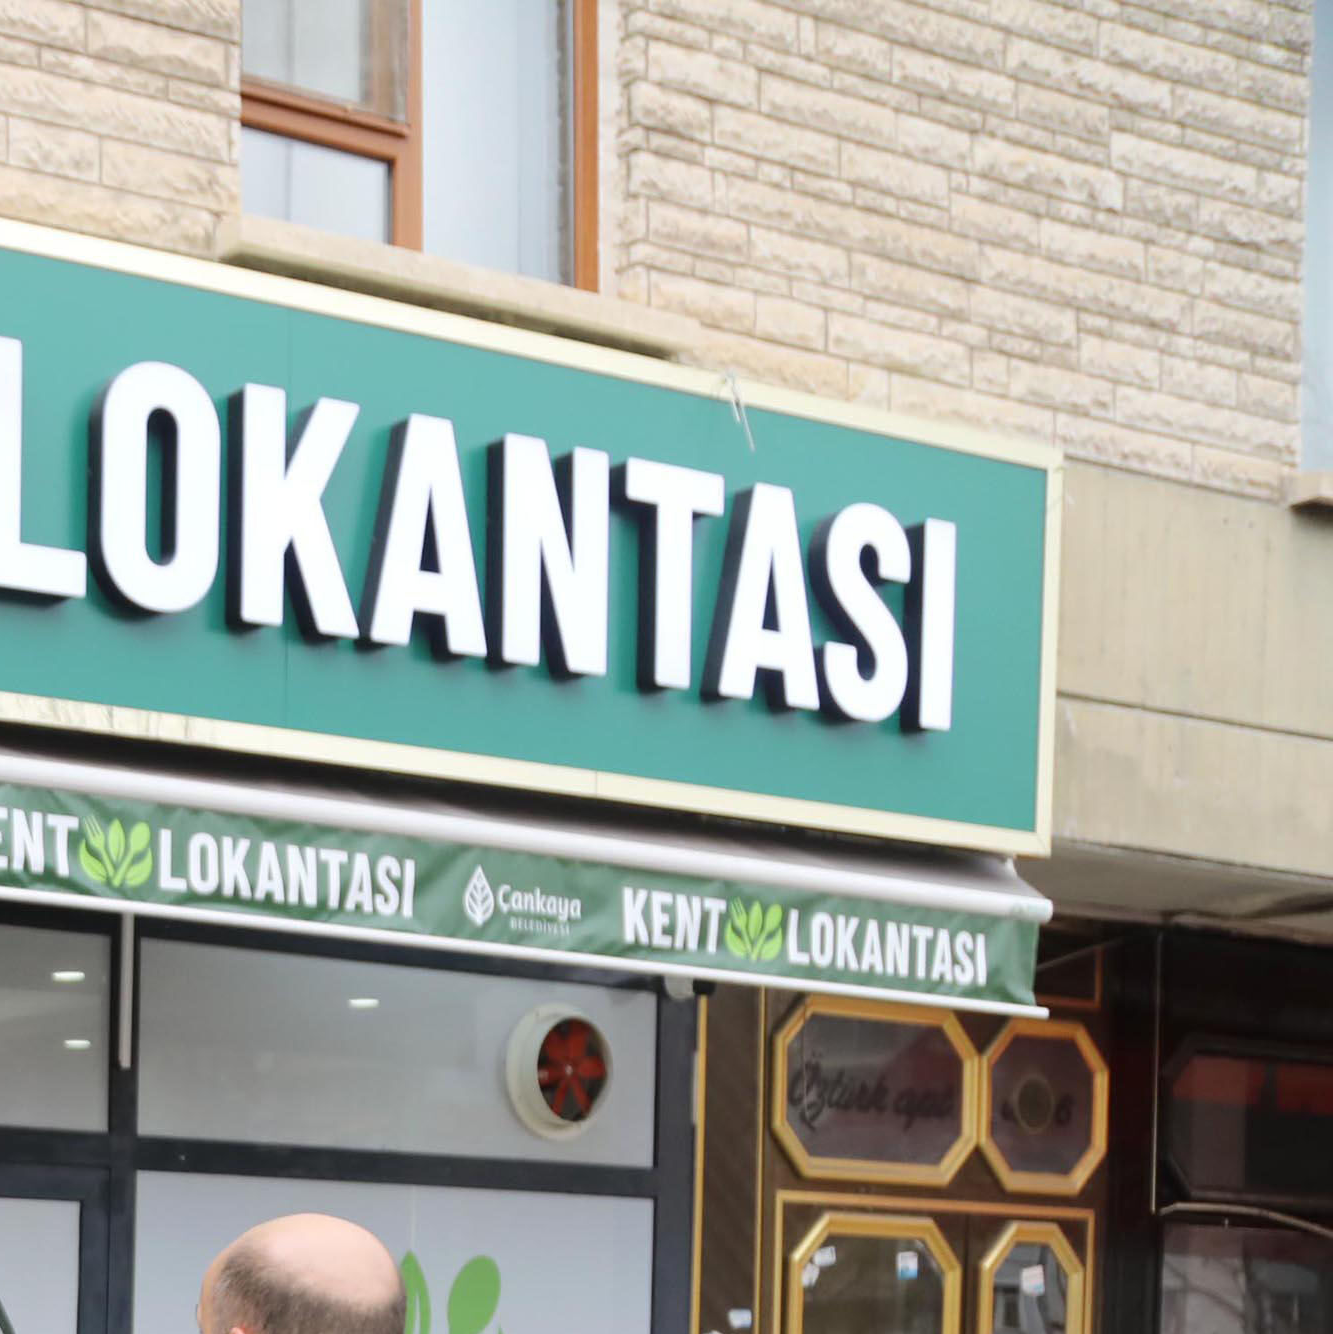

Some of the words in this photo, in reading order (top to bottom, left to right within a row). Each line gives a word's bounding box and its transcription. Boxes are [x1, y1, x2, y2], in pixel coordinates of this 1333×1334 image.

[156, 824, 417, 920] LOKANTASI
[497, 883, 582, 922] Çankaya
[622, 887, 728, 956] KENT
[786, 908, 988, 988] LOKANTASI
